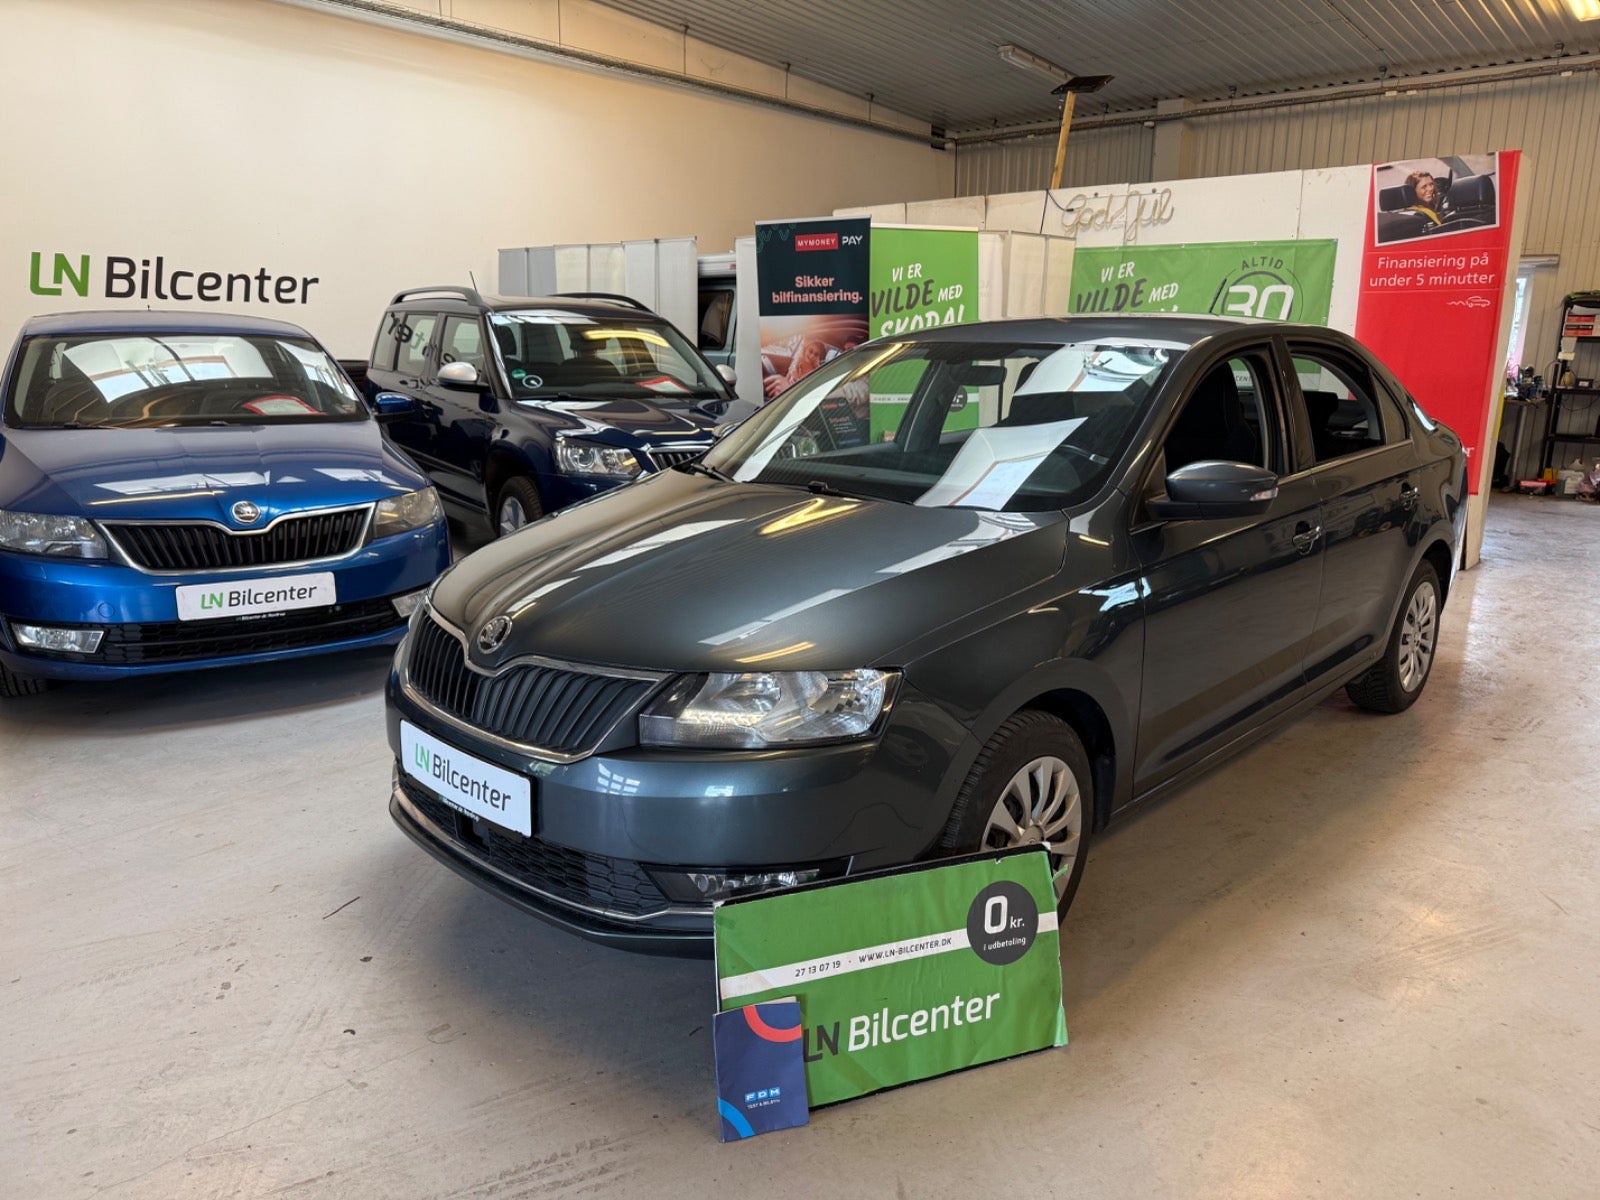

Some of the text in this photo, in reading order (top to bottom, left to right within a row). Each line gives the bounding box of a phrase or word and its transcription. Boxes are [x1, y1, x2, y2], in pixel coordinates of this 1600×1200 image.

[797, 235, 863, 247] MYMONEY PAY
[892, 263, 922, 282] VI ER
[1101, 261, 1135, 283] VI ER
[1241, 256, 1284, 271] ALTID
[1377, 251, 1489, 270] Finansiering på
[30, 252, 319, 304] LN Bilcenter
[795, 275, 835, 288] Sikker
[1369, 272, 1495, 287] under 5 minutter
[772, 289, 863, 304] bilfinansiering.
[871, 279, 963, 318] VILDE MED
[1076, 278, 1179, 313] VILDE MED
[1227, 284, 1295, 321] 30
[200, 585, 317, 609] LN Bilcenter
[414, 743, 431, 773] LN
[432, 754, 511, 812] Bilcenter
[984, 895, 1025, 934] 0 kr.
[795, 937, 952, 977] 27 13 07 19 WWW.LN-BILCENTER.DK
[848, 992, 1000, 1052] Bilcenter
